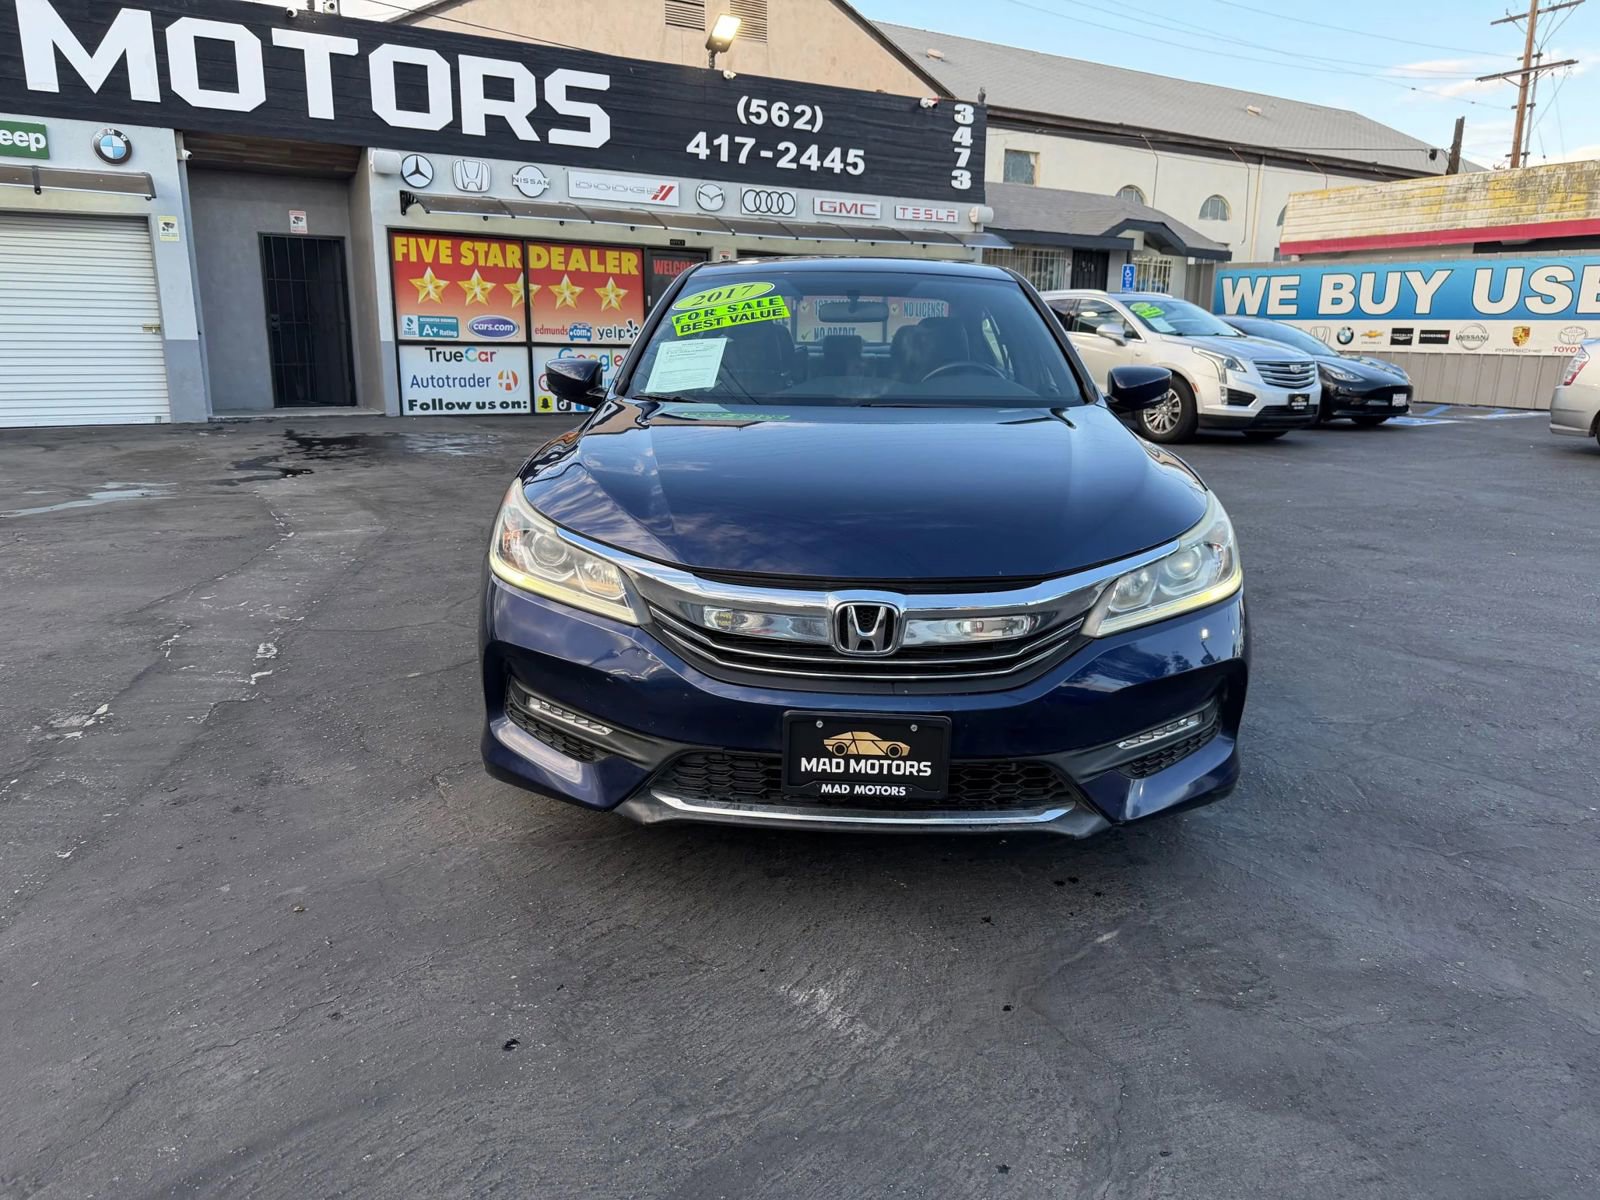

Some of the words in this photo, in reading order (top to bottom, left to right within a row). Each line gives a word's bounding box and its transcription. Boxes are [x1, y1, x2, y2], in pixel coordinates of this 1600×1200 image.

[16, 0, 611, 149] MOTORS
[737, 96, 823, 133] (562)
[0, 129, 47, 152] eep
[950, 103, 975, 190] 3473
[686, 131, 865, 175] 417-2445
[512, 176, 549, 186] NISSAN
[820, 201, 877, 216] GMC
[900, 207, 956, 221] TESLA
[394, 237, 453, 264] FIVE
[460, 241, 522, 269] STAR
[529, 244, 640, 275] DEALER
[690, 285, 755, 307] 2017
[1221, 274, 1301, 315] WE
[1317, 269, 1453, 316] BUY
[675, 308, 716, 324] FOR
[727, 297, 780, 313] SALE
[917, 302, 945, 316] LICENSE
[473, 322, 513, 331] cars.com
[680, 317, 723, 333] BEST
[729, 308, 783, 323] VALUE
[422, 324, 438, 336] A+
[535, 325, 568, 335] edmunds
[597, 326, 625, 340] yelp
[425, 347, 496, 362] TrueCar
[558, 347, 623, 371] Ggle
[410, 373, 491, 388] Autotrader
[408, 398, 472, 411] Follow
[475, 401, 496, 410] us
[499, 400, 528, 410] on:
[800, 757, 845, 774] MAD
[849, 759, 932, 776] MOTORS
[820, 783, 850, 794] MAD
[854, 785, 906, 796] MOTORS
